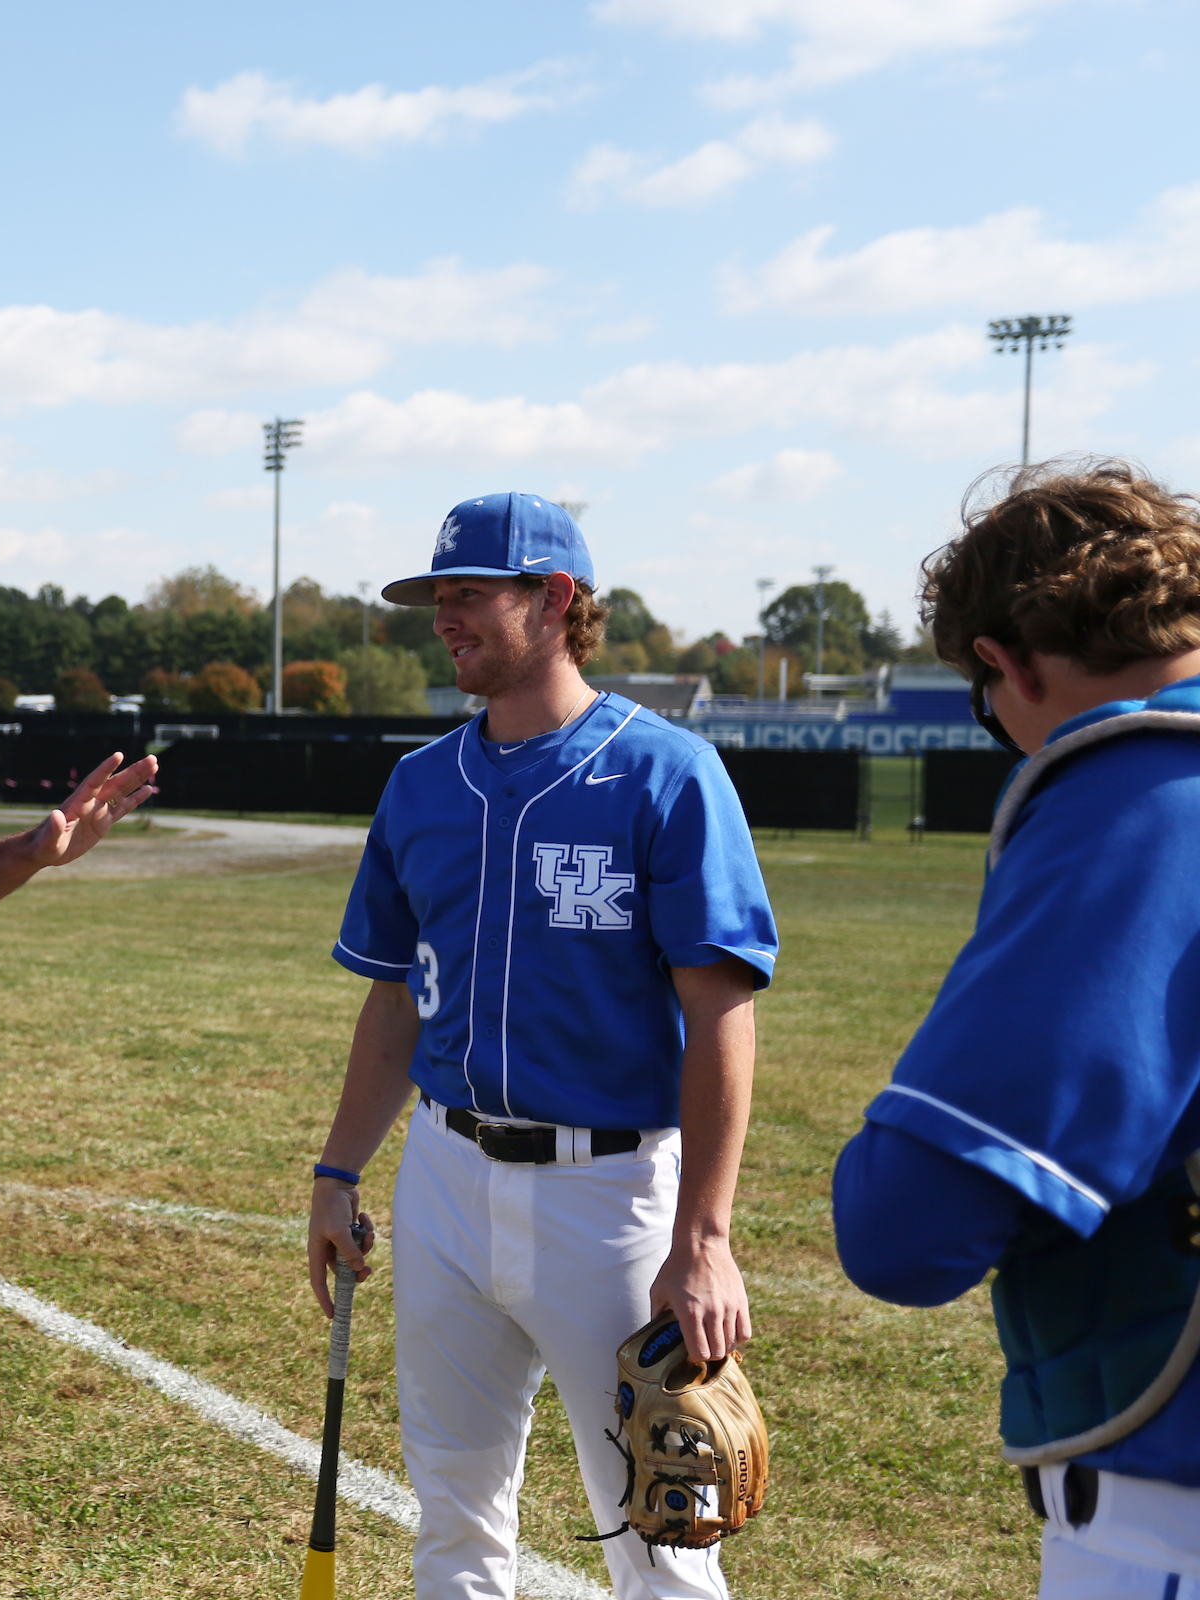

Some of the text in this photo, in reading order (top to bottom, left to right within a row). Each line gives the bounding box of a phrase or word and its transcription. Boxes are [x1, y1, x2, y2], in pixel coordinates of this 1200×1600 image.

[841, 725, 994, 753] SOCCER
[532, 842, 636, 930] UK
[416, 941, 440, 1020] 3
